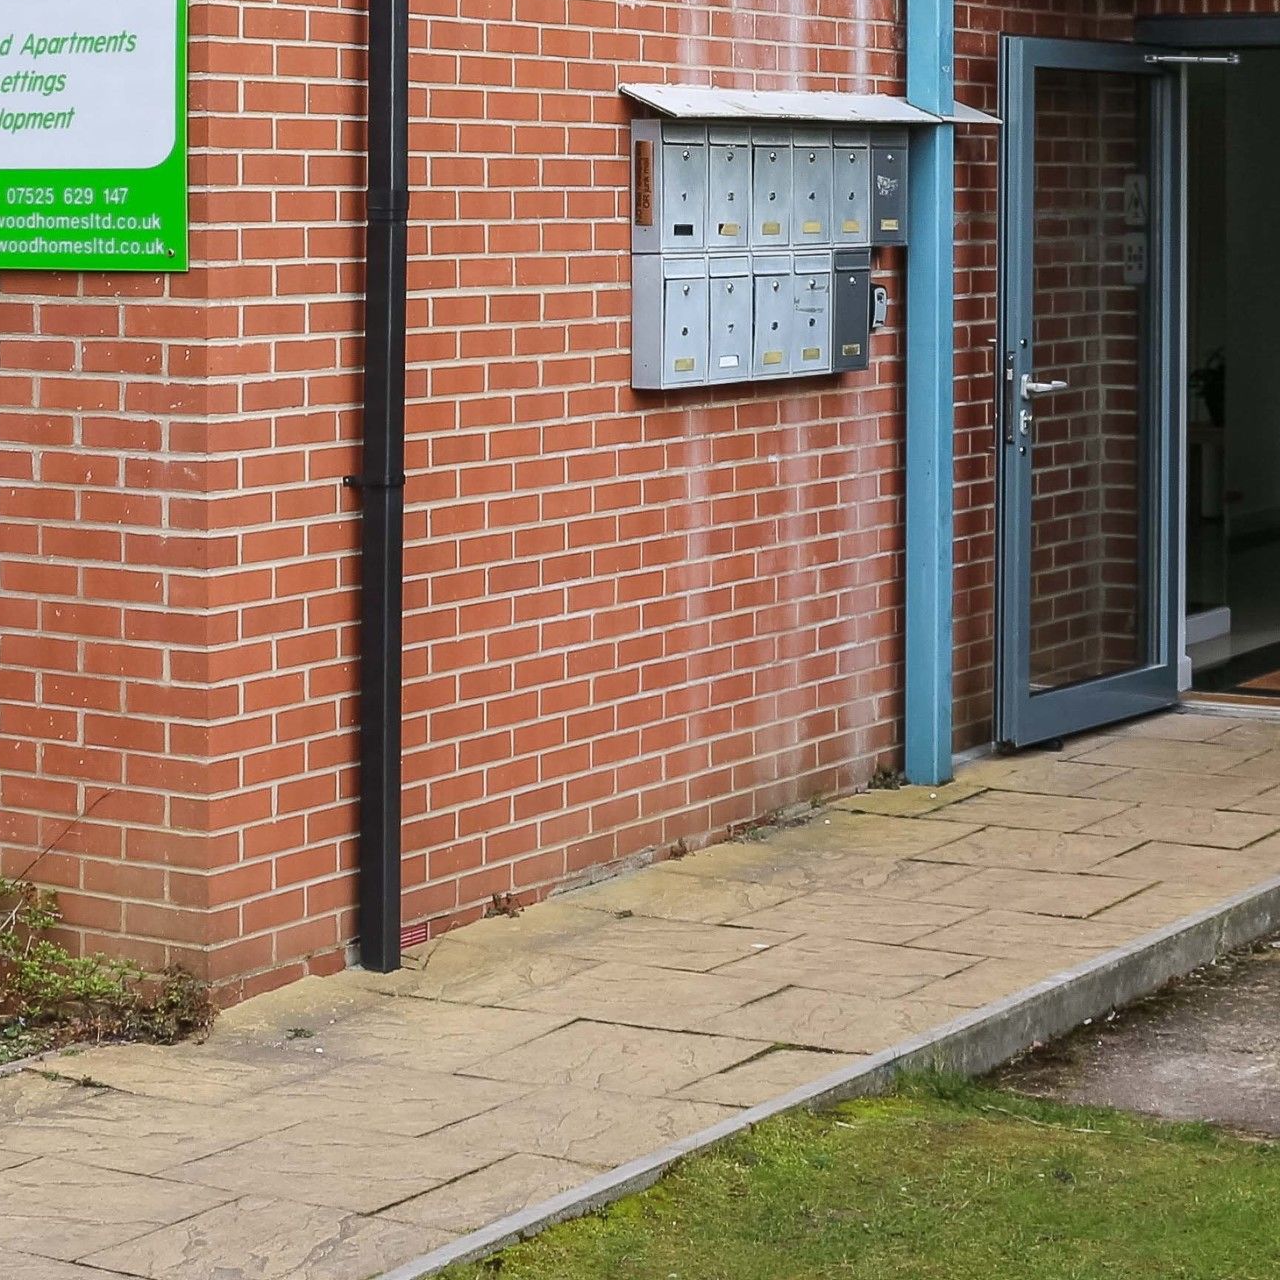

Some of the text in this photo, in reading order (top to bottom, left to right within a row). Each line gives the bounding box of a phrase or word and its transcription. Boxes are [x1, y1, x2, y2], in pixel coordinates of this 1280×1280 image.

[20, 30, 137, 59] Apartments
[6, 187, 55, 205] 07525
[63, 187, 94, 205] 629
[103, 187, 129, 205] 147
